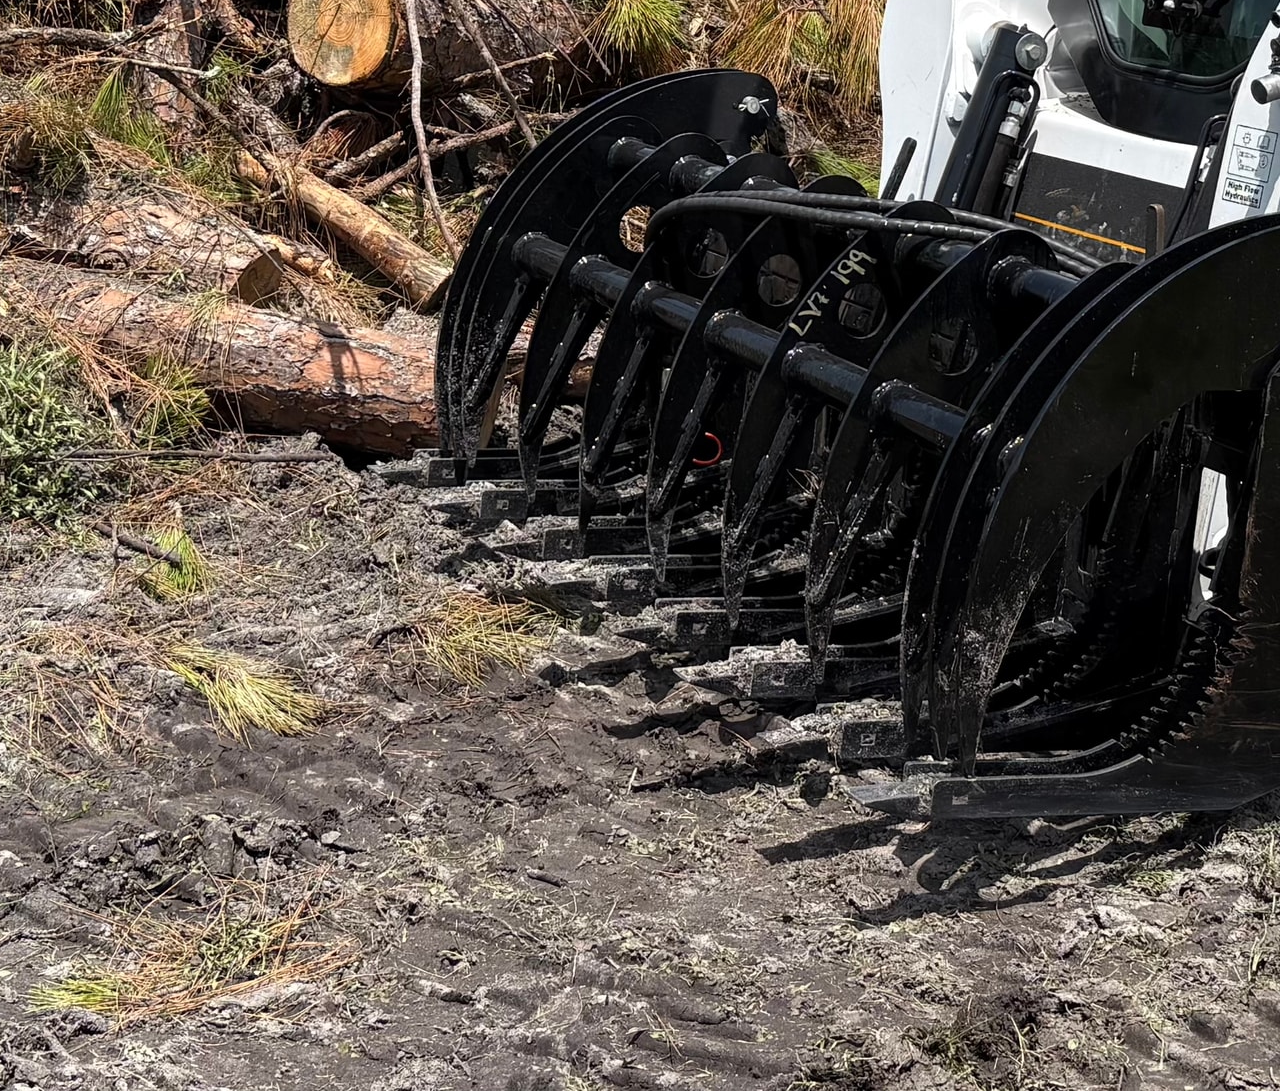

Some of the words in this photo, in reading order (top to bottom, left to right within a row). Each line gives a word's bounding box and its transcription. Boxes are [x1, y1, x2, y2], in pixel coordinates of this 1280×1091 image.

[1228, 181, 1242, 191] High
[1245, 185, 1259, 194] Flow
[830, 249, 878, 285] 199
